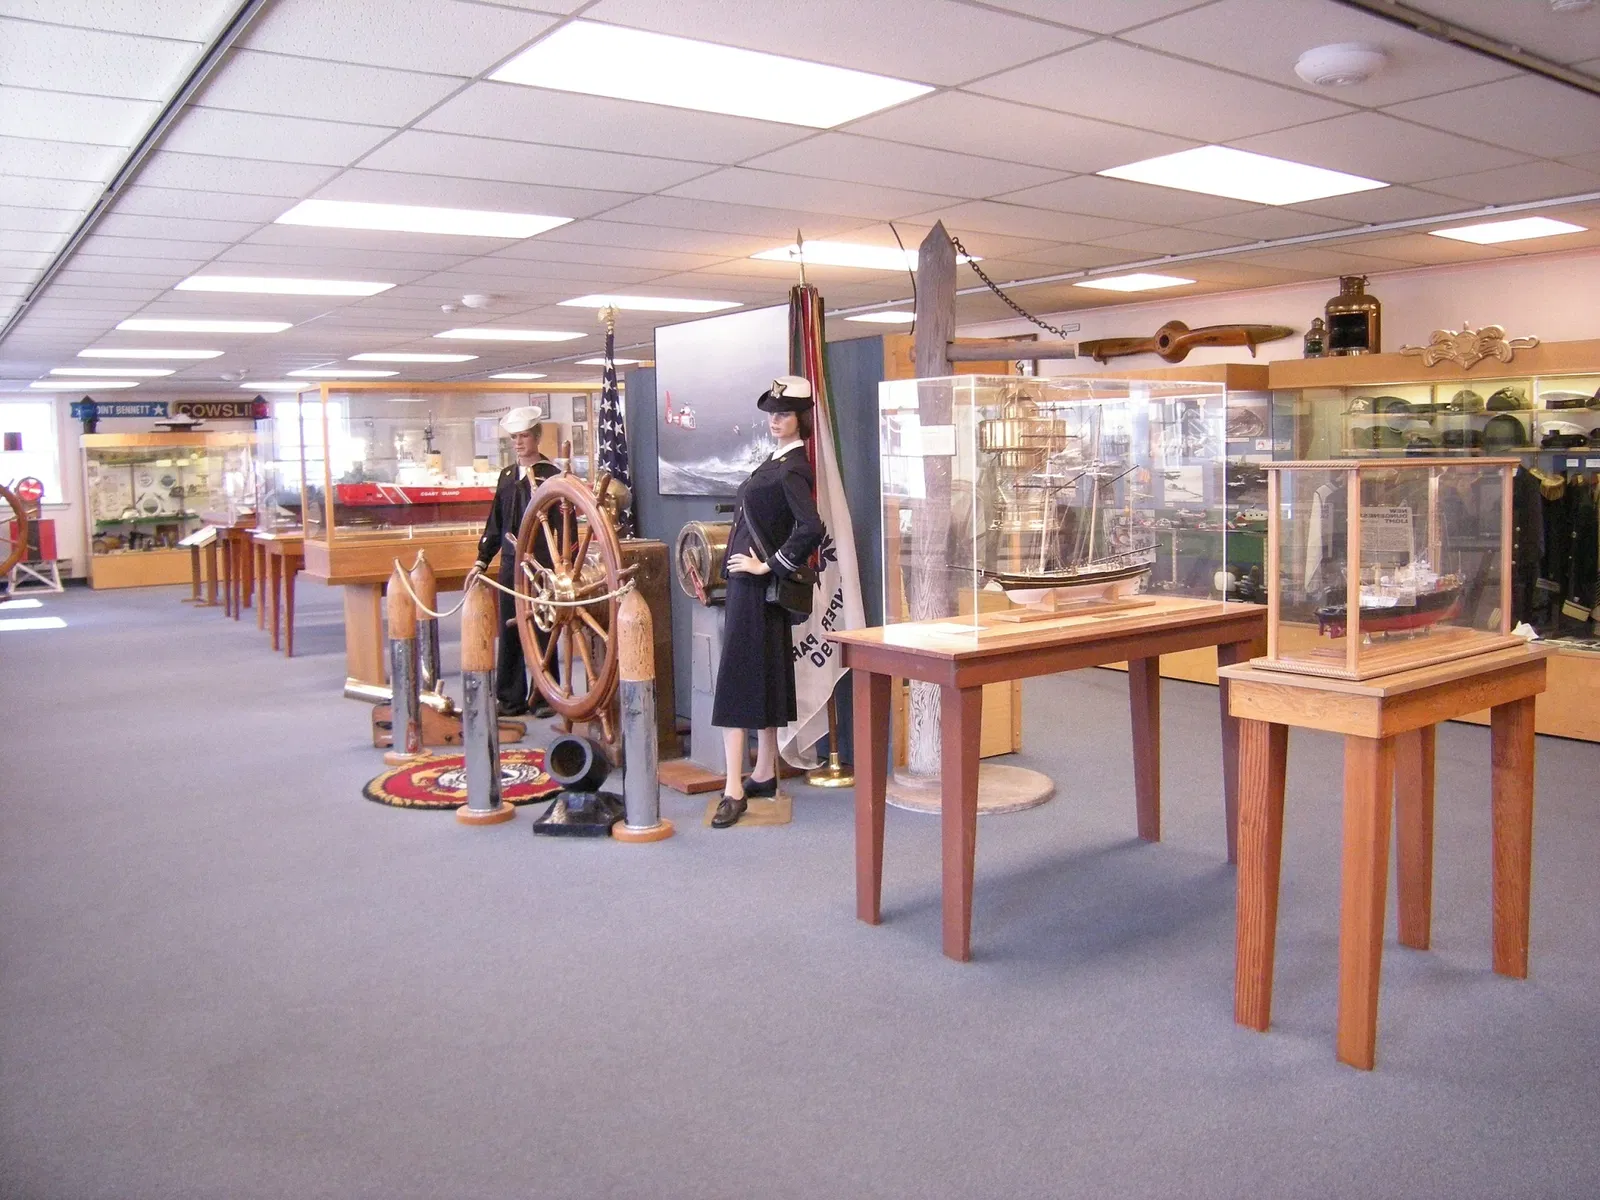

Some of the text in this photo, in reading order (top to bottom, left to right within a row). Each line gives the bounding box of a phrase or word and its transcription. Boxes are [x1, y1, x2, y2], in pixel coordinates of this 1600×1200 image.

[96, 405, 150, 415] OINT BENNETT
[180, 403, 252, 417] COWSLI
